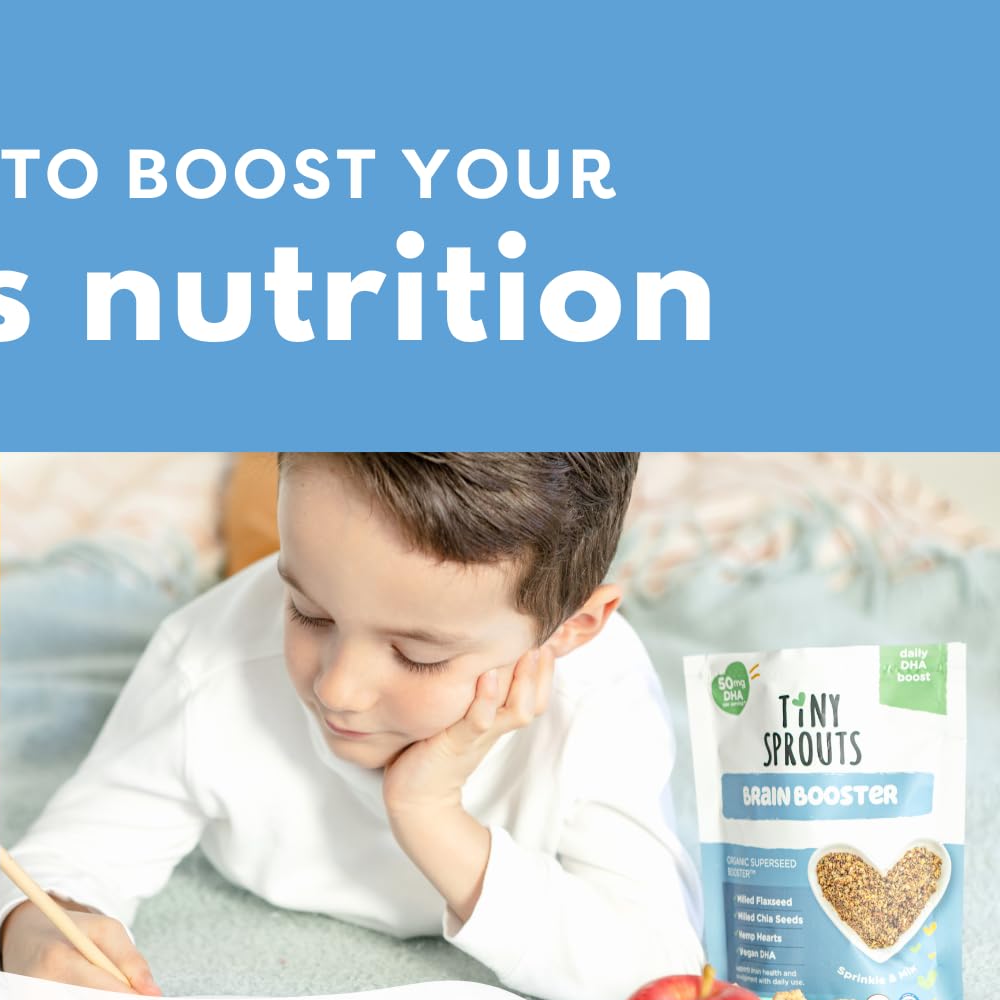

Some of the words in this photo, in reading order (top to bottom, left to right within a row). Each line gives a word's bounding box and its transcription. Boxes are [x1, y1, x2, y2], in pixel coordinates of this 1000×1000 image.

[899, 647, 929, 660] daily
[900, 660, 927, 671] DHA
[896, 671, 931, 682] boost
[717, 676, 746, 690] 50mg
[723, 690, 744, 702] DHA
[763, 731, 863, 767] SPROUTS
[750, 857, 797, 869] SUPERSEED
[756, 896, 793, 907] Flaxseed
[756, 913, 774, 924] Chia
[775, 914, 804, 925] Seeds
[756, 932, 783, 943] Hearts
[739, 948, 759, 959] Vegan
[760, 949, 777, 960] DHA
[783, 969, 797, 977] and
[836, 966, 886, 985] Sprinkle
[772, 978, 789, 987] daily
